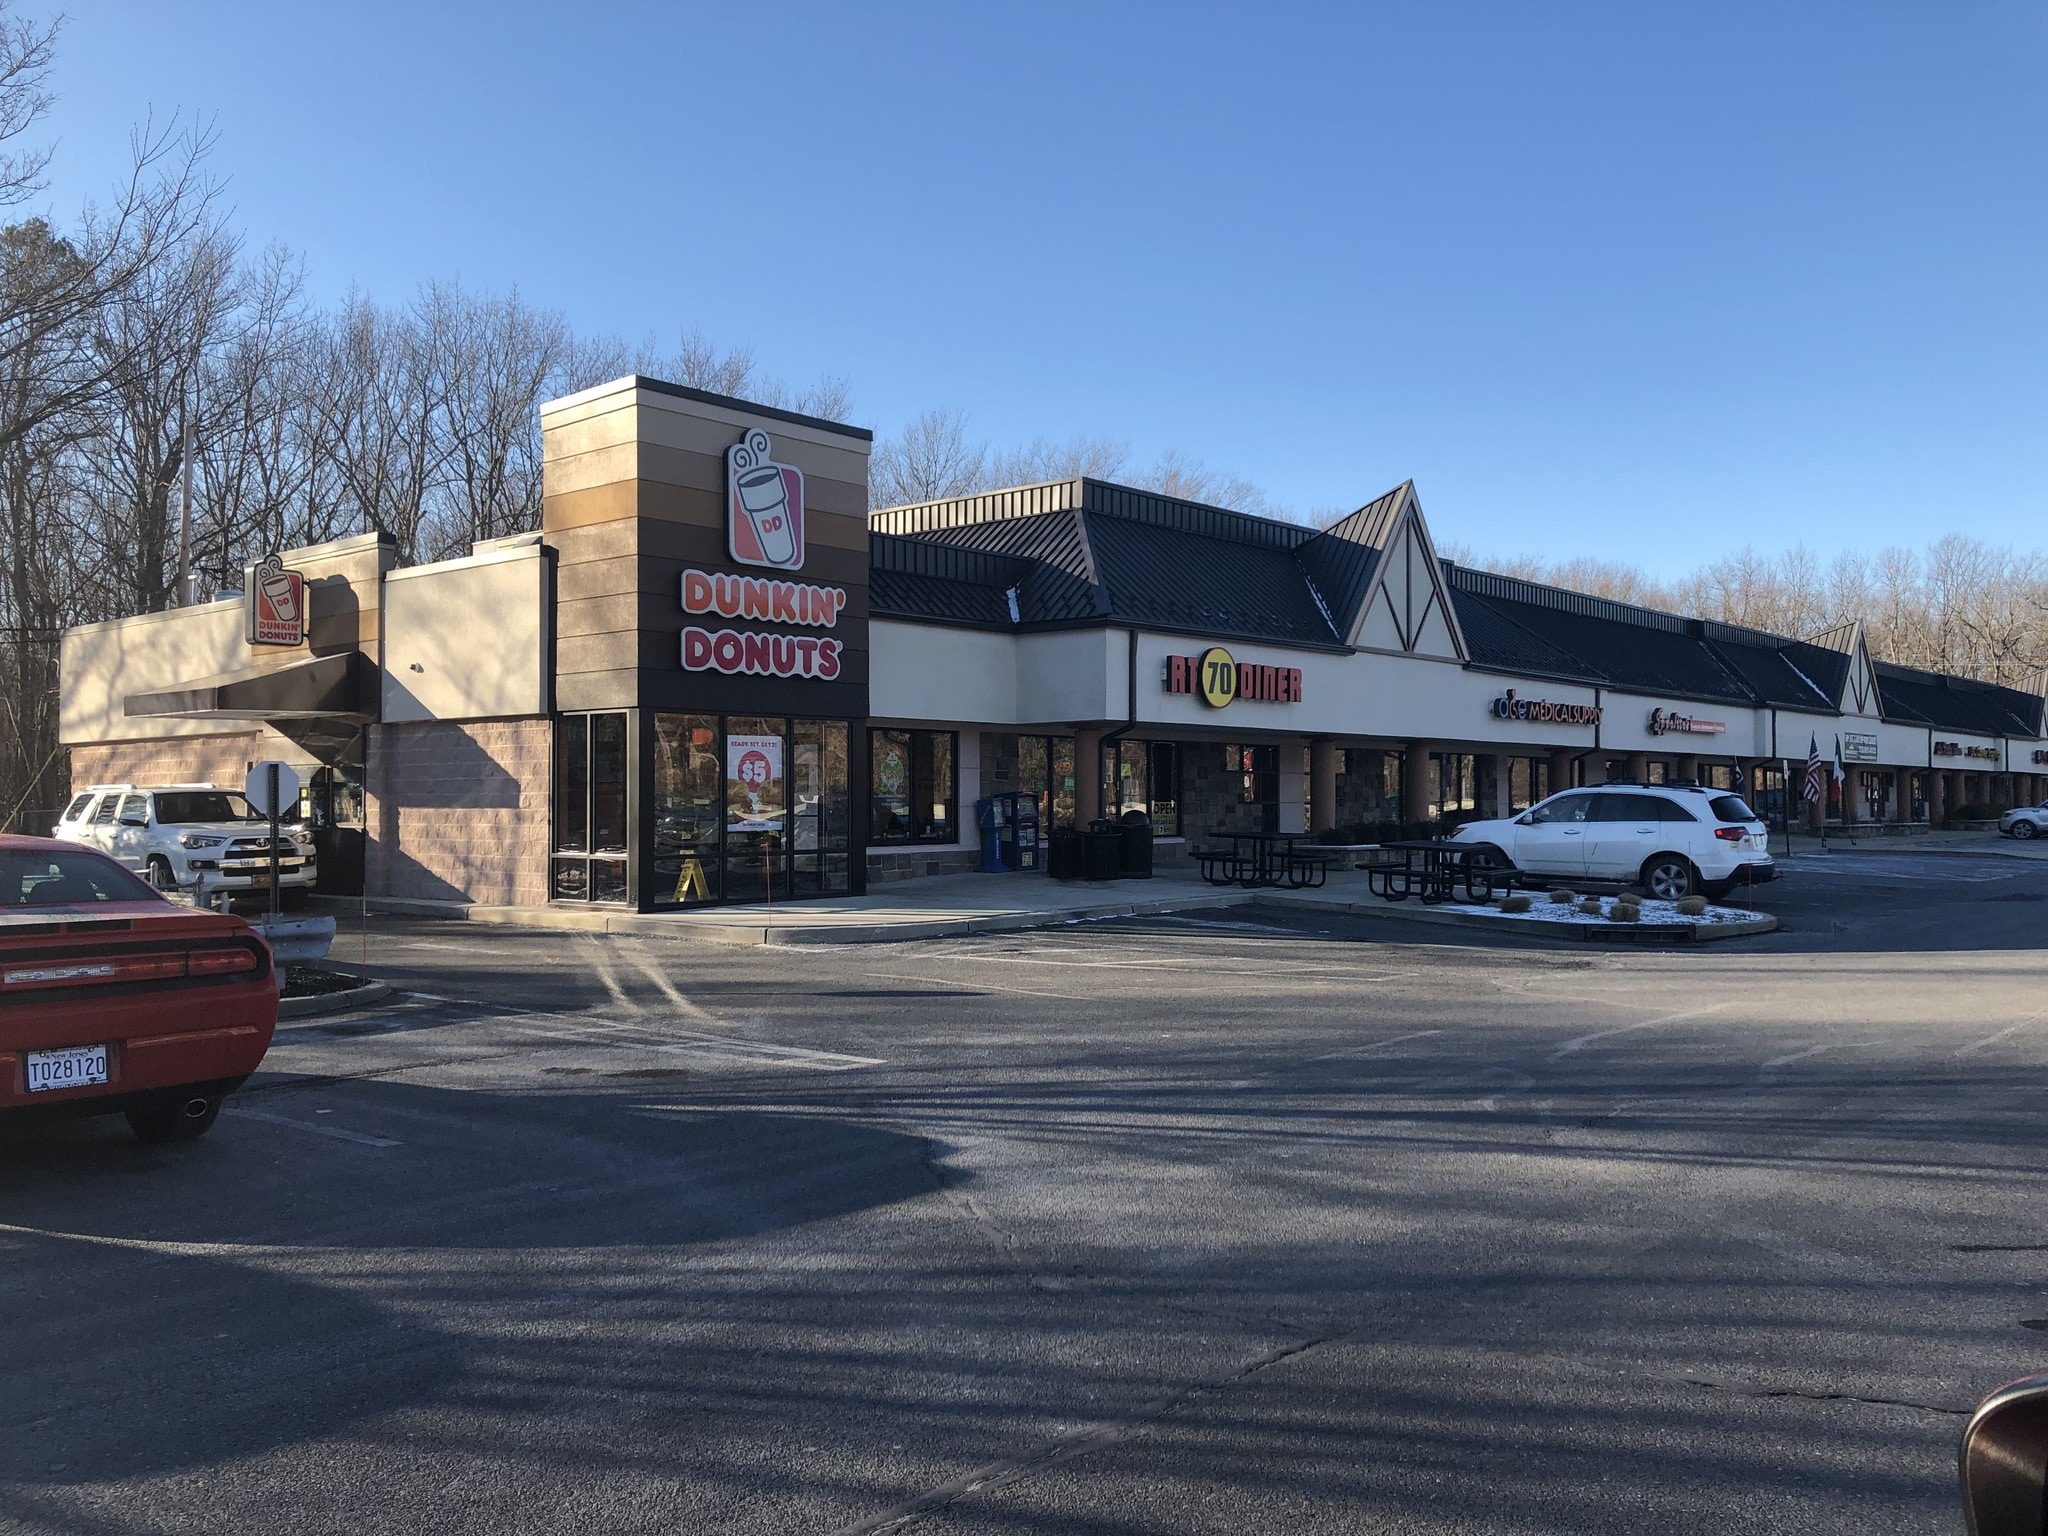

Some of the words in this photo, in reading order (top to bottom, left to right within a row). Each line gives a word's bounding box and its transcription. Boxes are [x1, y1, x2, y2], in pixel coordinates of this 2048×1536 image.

[760, 515, 783, 534] DD
[684, 572, 845, 627] DUNKIN'
[259, 621, 300, 631] DUNKIN'
[259, 631, 298, 641] DONUTS
[684, 629, 840, 677] DONUTS
[1168, 655, 1201, 694] RT
[1207, 661, 1232, 695] 70
[1237, 662, 1302, 703] DINER
[742, 760, 767, 783] $5
[1153, 803, 1176, 815] OPEN
[30, 1056, 105, 1082] T028120
